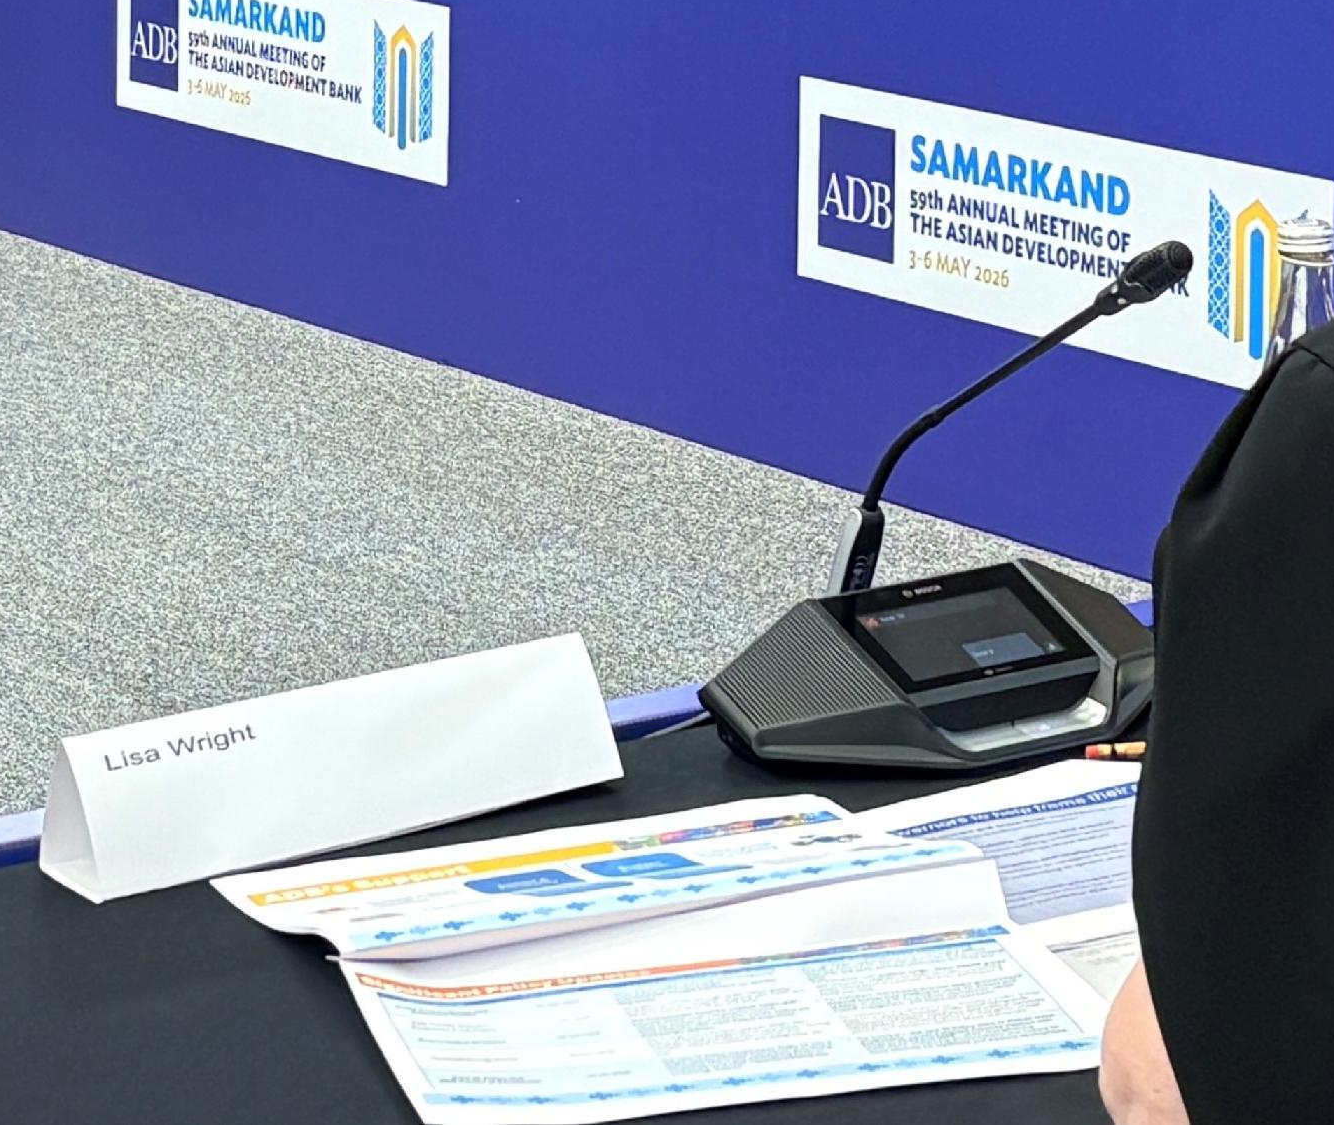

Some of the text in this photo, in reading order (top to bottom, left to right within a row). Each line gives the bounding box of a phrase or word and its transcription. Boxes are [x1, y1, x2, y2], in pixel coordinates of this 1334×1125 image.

[131, 20, 178, 66] ADB
[188, 31, 326, 72] 59th ANNUAL MEETING OF
[188, 50, 363, 105] THE ASIAN DEVELOPMENT BANK
[205, 81, 227, 101] MAY
[910, 134, 1131, 217] SAMARKAND
[819, 171, 894, 232] ADB
[909, 188, 1132, 253] 59th ANNUAL MEETING OF
[909, 213, 944, 240] THE
[946, 221, 998, 256] ASIAN
[908, 248, 1010, 289] 3-6 MAY 2026
[104, 724, 256, 772] Lisa Wright
[1087, 785, 1128, 803] their
[265, 883, 350, 905] ADB's
[353, 864, 472, 891] Support
[485, 979, 552, 995] Policy
